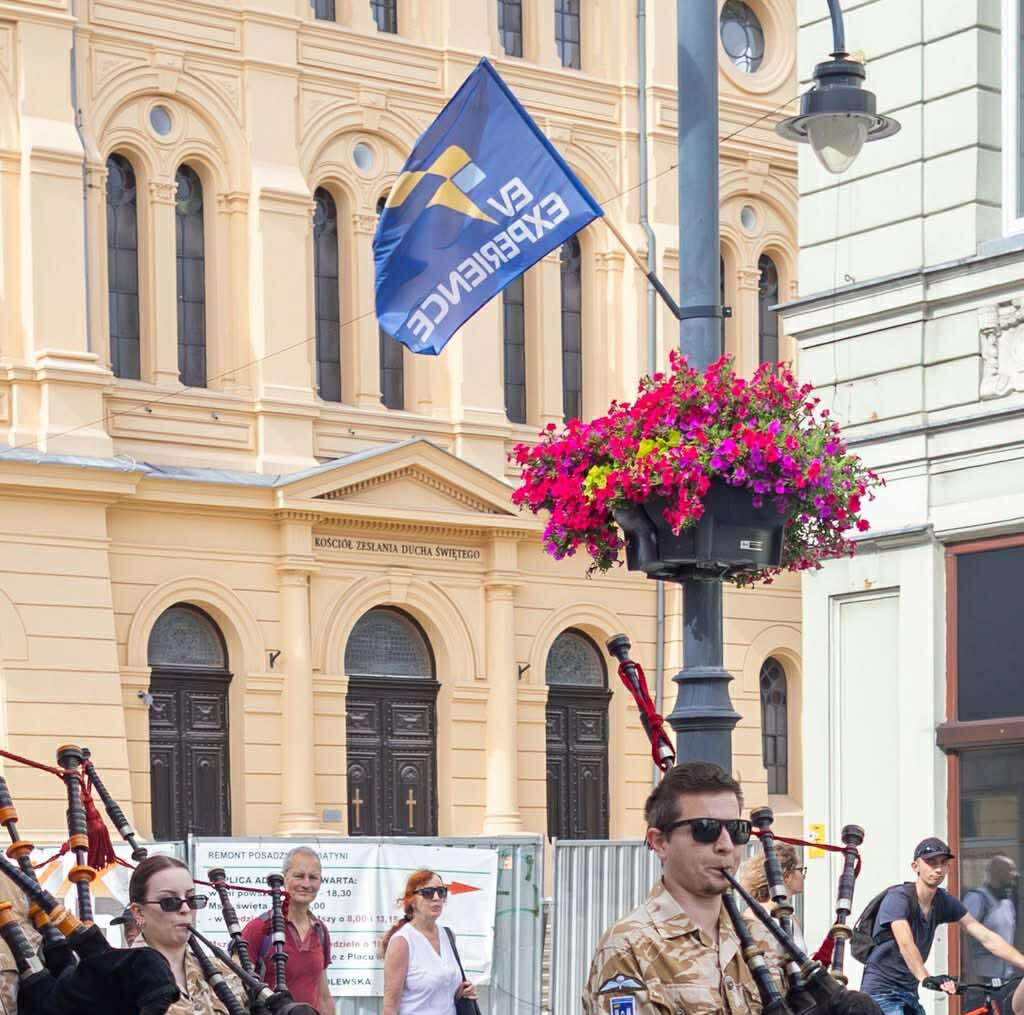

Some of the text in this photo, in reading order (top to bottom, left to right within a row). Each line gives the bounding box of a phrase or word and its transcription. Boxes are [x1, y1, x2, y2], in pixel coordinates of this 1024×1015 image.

[314, 536, 353, 550] KOŚCIÓŁ
[401, 544, 433, 556] DUCHA
[435, 546, 480, 560] ŚWIĘTEGO
[208, 851, 245, 860] REMONT
[248, 851, 288, 860] POSADZ
